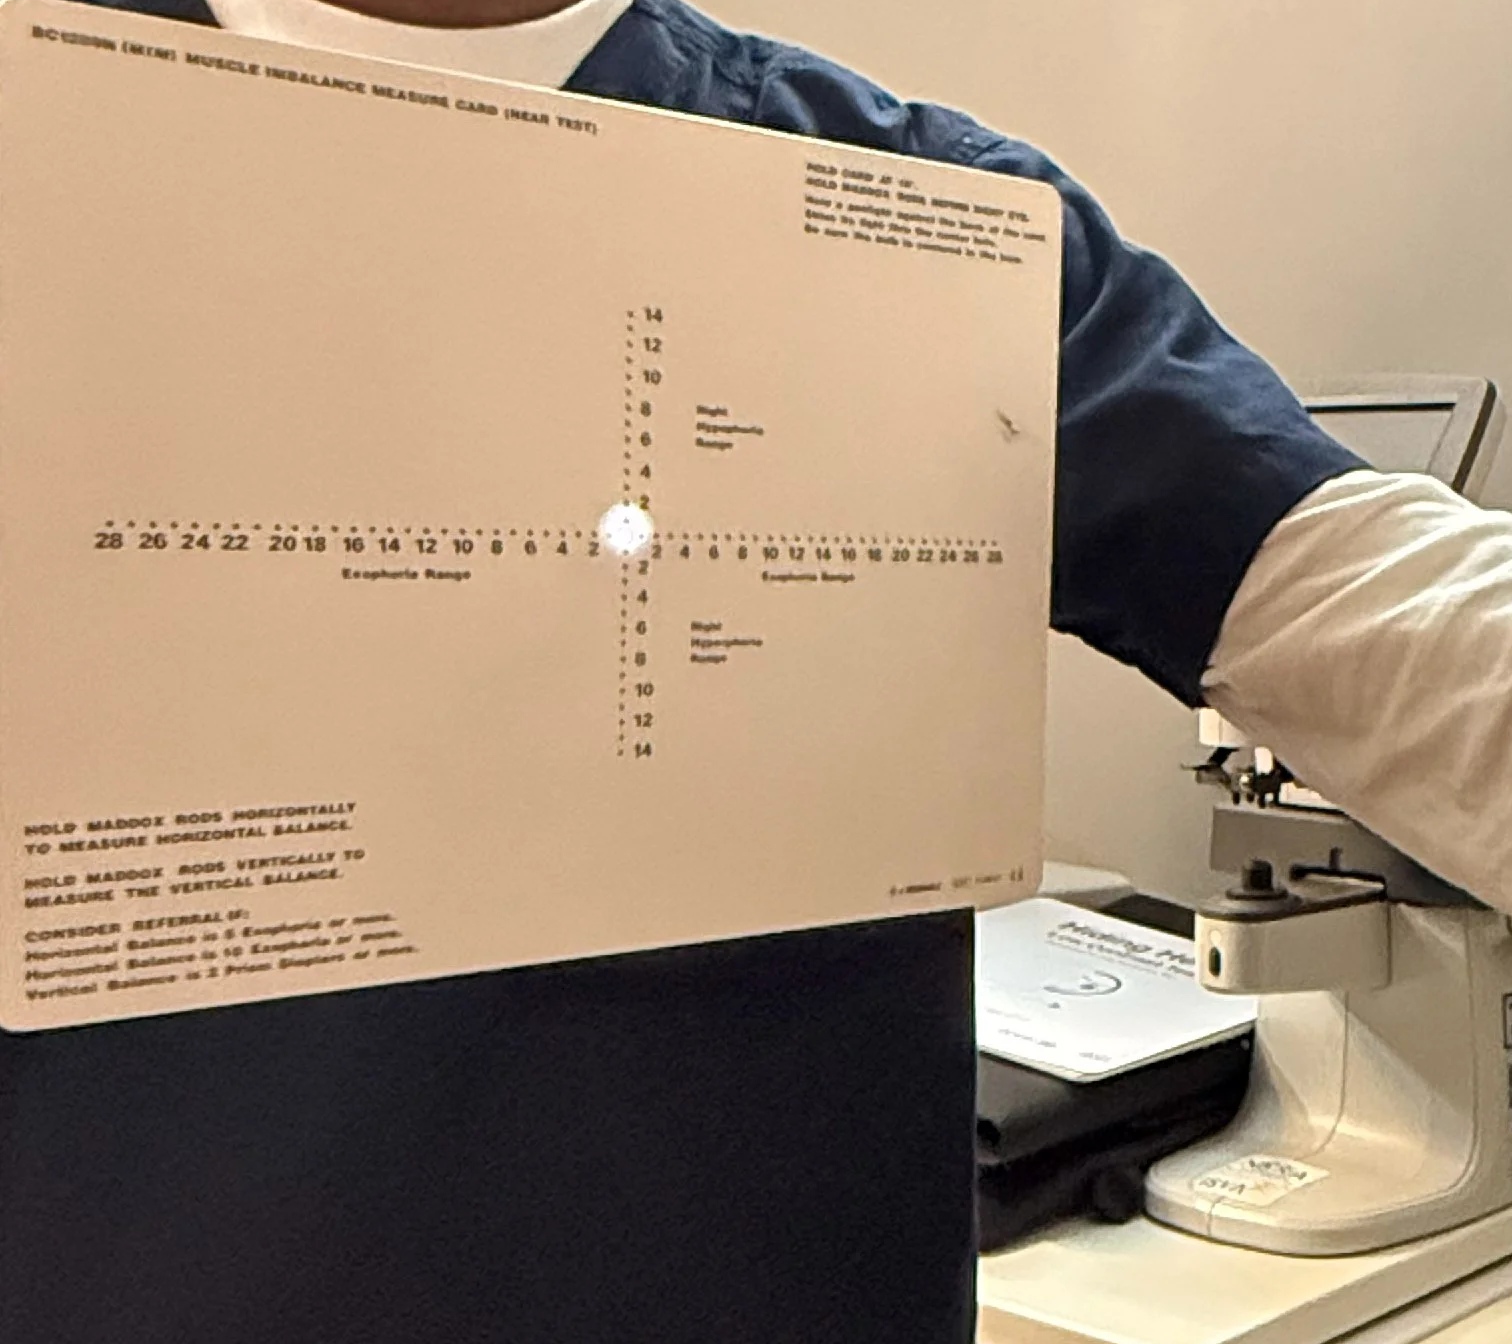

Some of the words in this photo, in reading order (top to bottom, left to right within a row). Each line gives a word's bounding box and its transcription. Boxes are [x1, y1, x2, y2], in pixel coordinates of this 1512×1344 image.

[185, 52, 260, 75] MUSCLE
[265, 66, 366, 94] IMBALANCE
[455, 99, 498, 115] CARD
[644, 307, 663, 323] 14
[643, 337, 662, 353] 12
[643, 369, 662, 385] 10
[640, 401, 651, 417] 8
[640, 432, 651, 447] 6
[640, 464, 651, 479] 4
[640, 494, 649, 510] 2
[94, 532, 123, 549] 28
[138, 533, 168, 549] 26
[180, 533, 211, 550] 24
[221, 535, 249, 551] 22
[269, 535, 297, 551] 20
[303, 537, 326, 553] 18
[343, 537, 365, 553] 16
[378, 537, 401, 553] 14
[415, 538, 437, 554] 12
[453, 539, 473, 555] 10
[491, 539, 503, 555] 8
[556, 541, 568, 555] 4
[588, 541, 599, 557] 2
[651, 544, 662, 559] 2
[680, 545, 689, 559] 4
[709, 545, 719, 560] 6
[762, 547, 779, 561] 10
[789, 546, 805, 561] 12
[815, 547, 831, 561] 14
[841, 547, 856, 562] 16
[892, 548, 910, 562] 20
[917, 548, 933, 562] 22
[939, 549, 957, 563] 24
[424, 568, 471, 582] Range
[638, 560, 649, 575] 2
[637, 589, 648, 605] 4
[635, 621, 647, 635] 6
[635, 683, 654, 698] 10
[634, 712, 653, 727] 12
[634, 743, 652, 758] 14
[24, 823, 77, 836] HOLD
[87, 816, 164, 832] MADDOX
[175, 812, 222, 825] RODS
[232, 803, 356, 821] HORIZONTALLY
[24, 843, 51, 855] TO
[59, 836, 148, 853] MEASURE
[155, 827, 267, 845] HORIZONTAL
[273, 820, 352, 836] BALANCE.
[24, 875, 77, 890] HOLD
[85, 867, 163, 884] MADDOX
[178, 861, 225, 875] RODS
[236, 852, 335, 871] VERTICALLY
[343, 849, 365, 860] TO
[24, 889, 114, 909] MEASURE
[124, 886, 160, 898] THE
[169, 877, 254, 895] VERTICAL
[262, 868, 344, 885] BALANCE.
[24, 923, 121, 943] CONSIDER
[132, 912, 223, 931] REFERRAL
